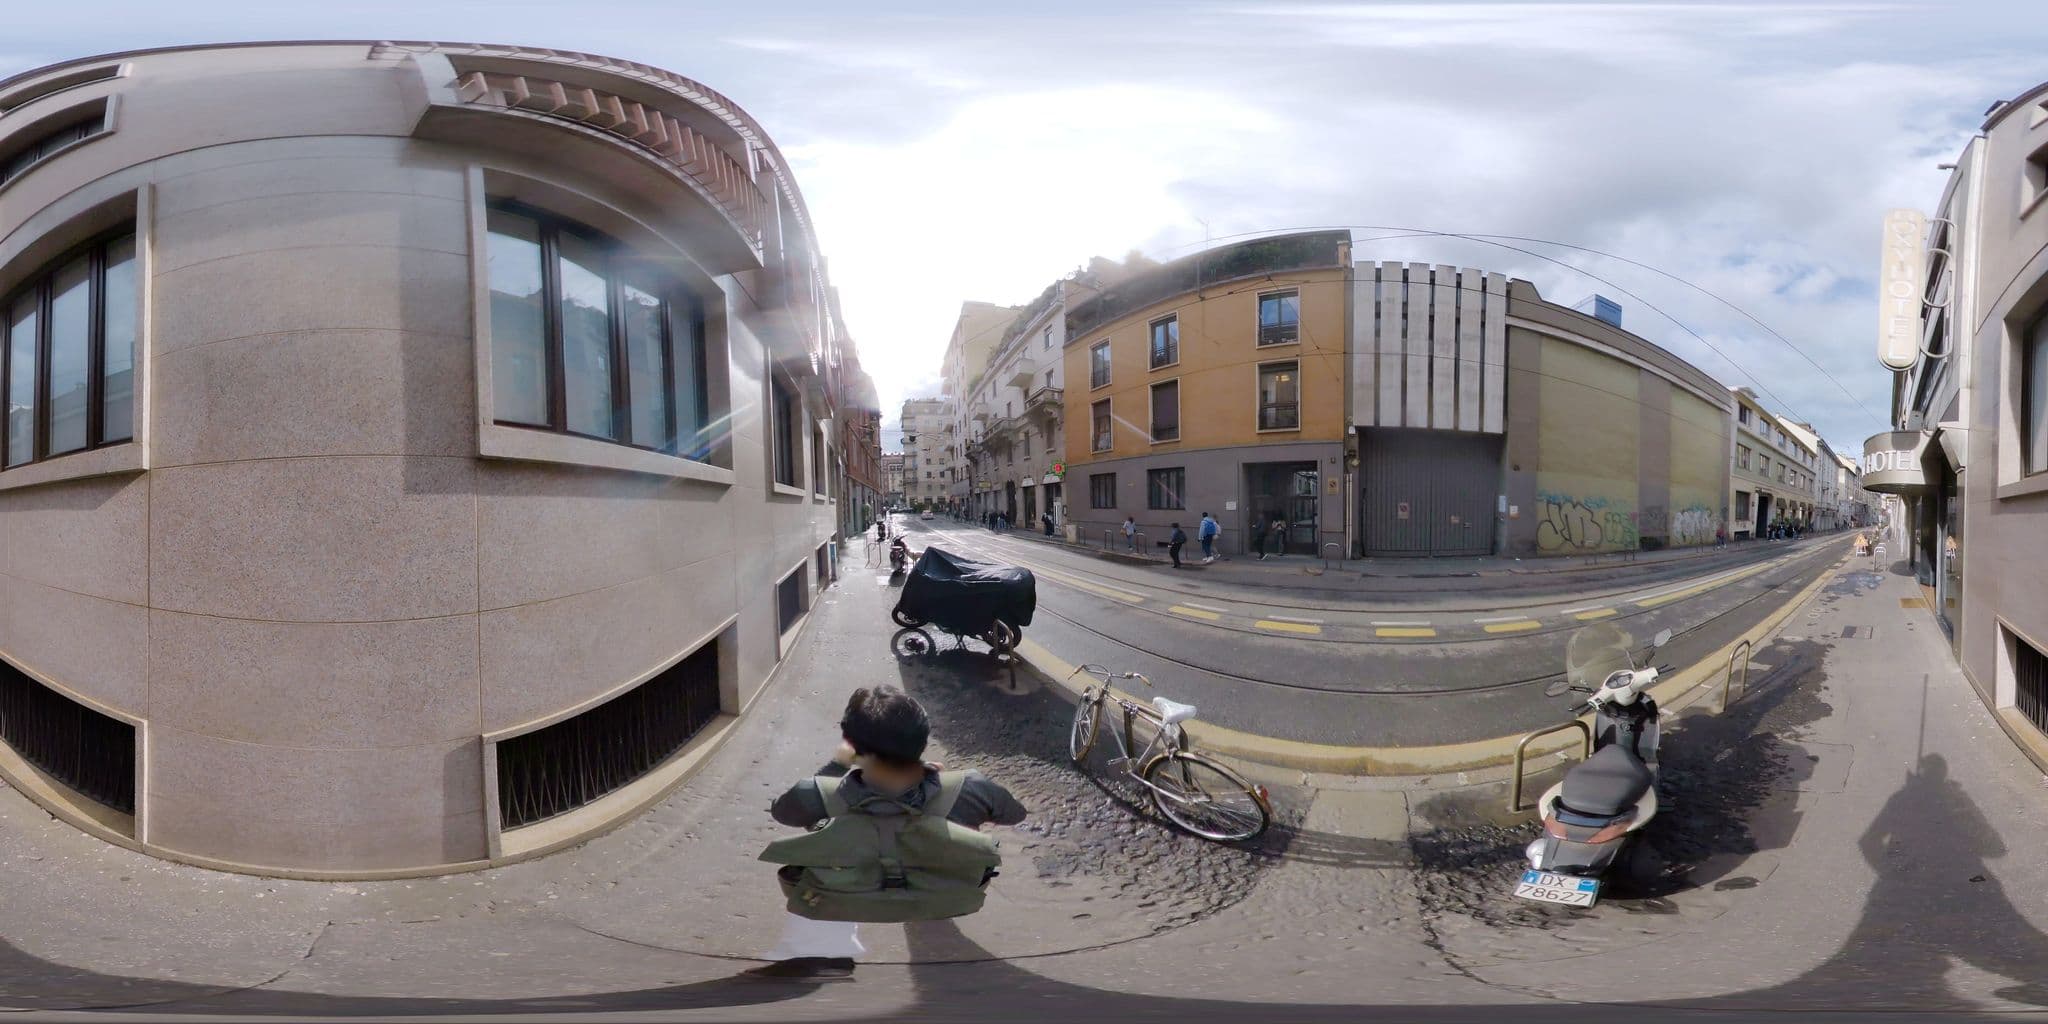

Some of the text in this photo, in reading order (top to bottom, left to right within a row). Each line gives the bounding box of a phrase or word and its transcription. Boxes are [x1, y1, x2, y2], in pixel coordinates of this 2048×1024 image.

[1887, 264, 1915, 360] HOTEL
[1866, 450, 1921, 474] HOTEL
[1540, 874, 1567, 888] DX
[1519, 884, 1588, 903] 78627
